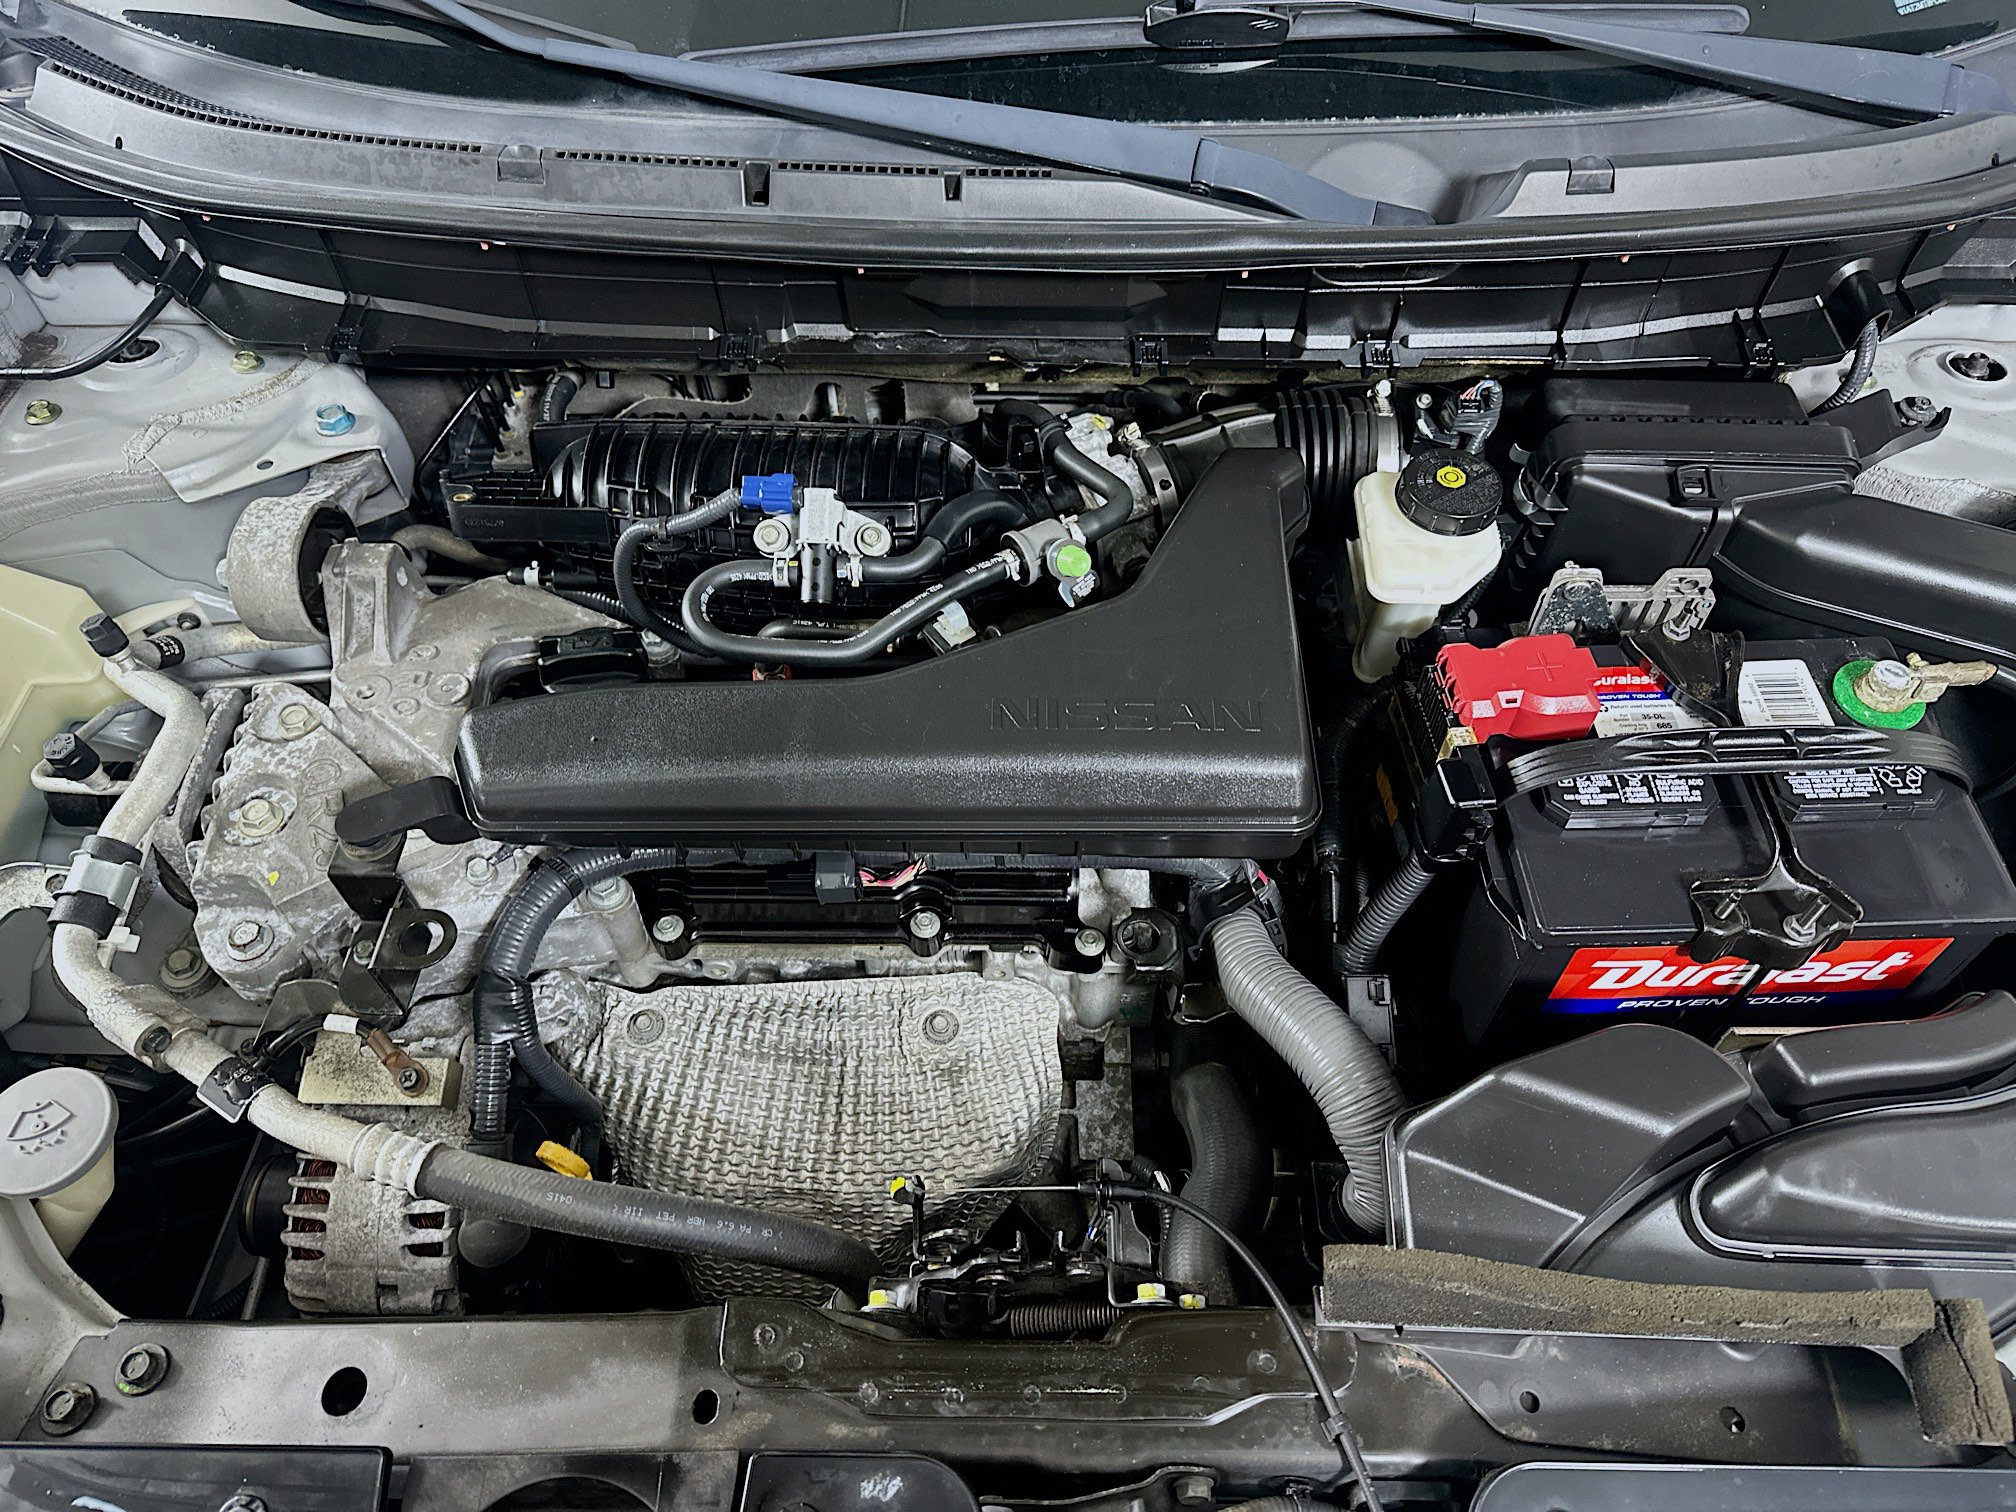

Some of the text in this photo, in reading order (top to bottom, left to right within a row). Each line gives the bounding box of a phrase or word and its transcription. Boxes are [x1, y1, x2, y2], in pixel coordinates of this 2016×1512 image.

[990, 699, 1261, 731] NISSAN
[1616, 995, 1827, 1010] PROVEN OUGH
[547, 1192, 573, 1205] 0415
[656, 1208, 676, 1222] PET
